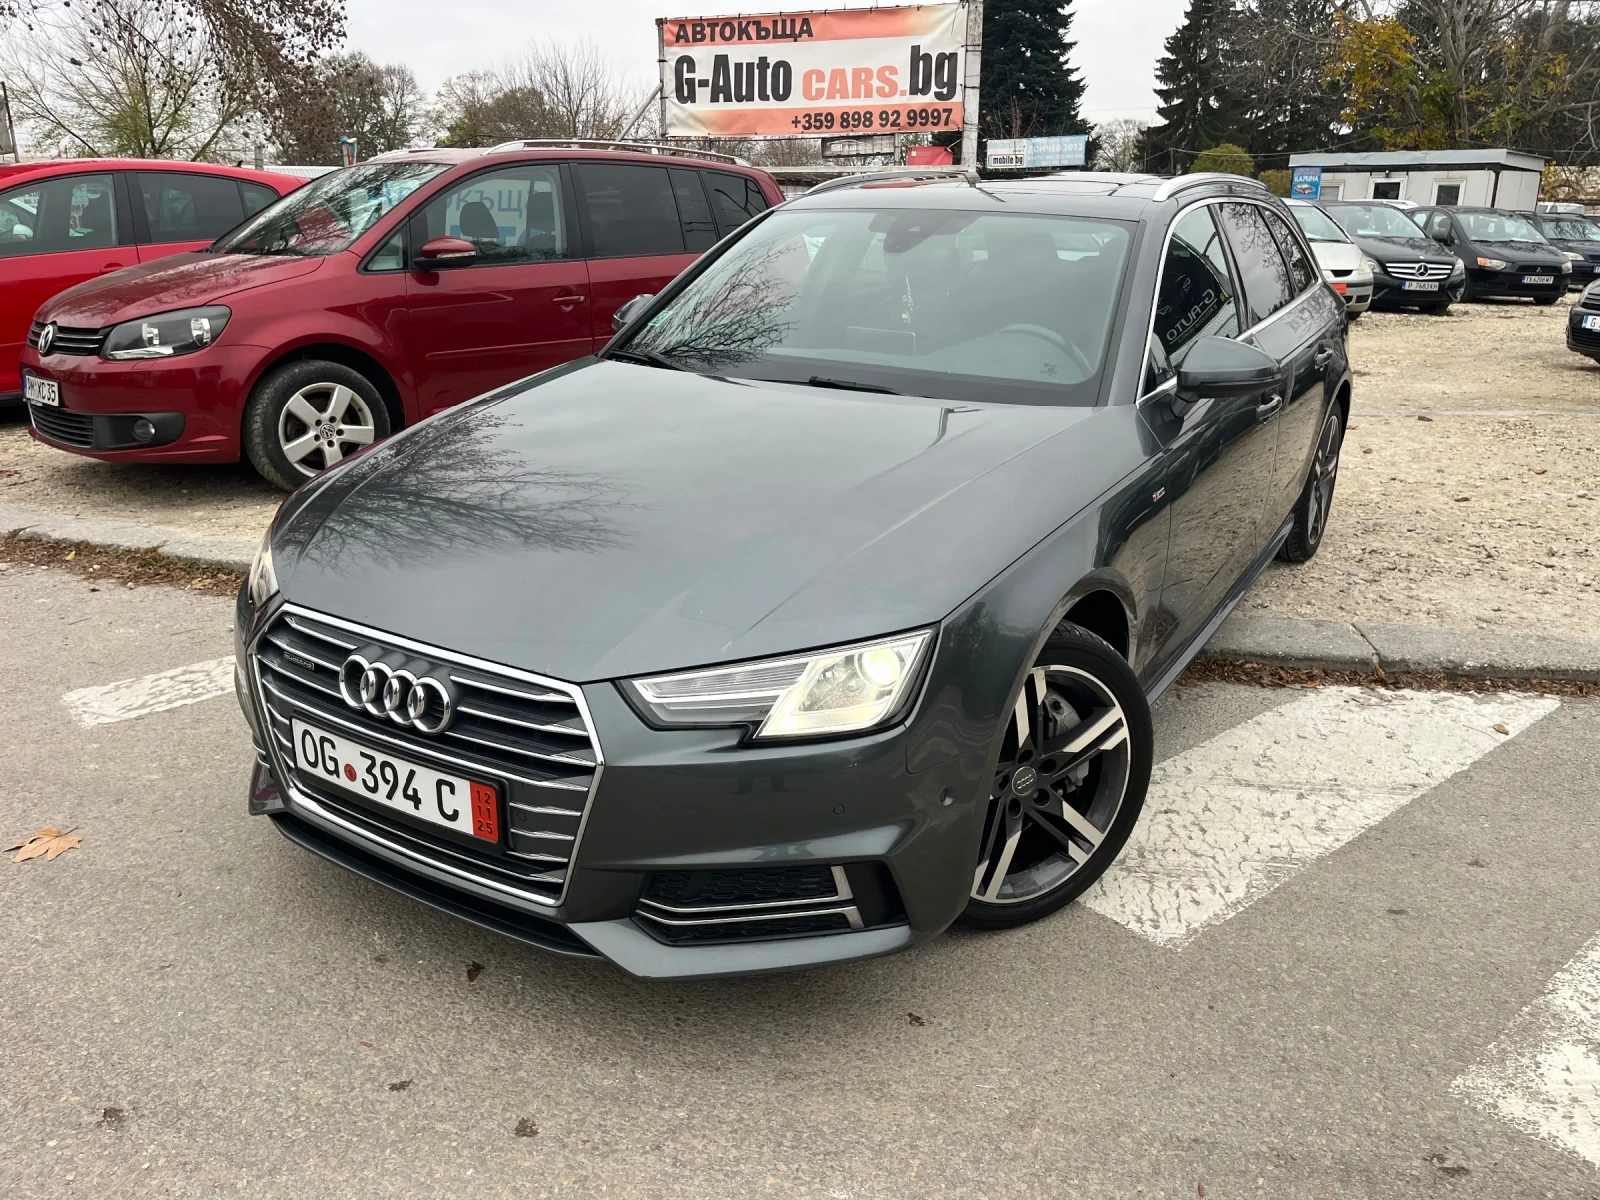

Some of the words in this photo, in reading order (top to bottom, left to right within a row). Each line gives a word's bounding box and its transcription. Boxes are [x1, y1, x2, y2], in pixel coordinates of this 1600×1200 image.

[675, 18, 814, 43] АВТОКЪЩА
[674, 54, 793, 104] G-Auto
[802, 44, 958, 102] CARS.bg
[791, 111, 835, 131] +359
[839, 109, 874, 129] 898
[878, 109, 901, 128] 92
[906, 108, 953, 127] 9997
[1063, 143, 1083, 152] 2012
[446, 189, 529, 218] КЪЩ
[301, 728, 340, 779] OG
[359, 750, 422, 811] 394
[435, 778, 460, 822] C
[476, 789, 491, 804] 12
[477, 804, 491, 820] 11
[477, 819, 493, 834] 25
